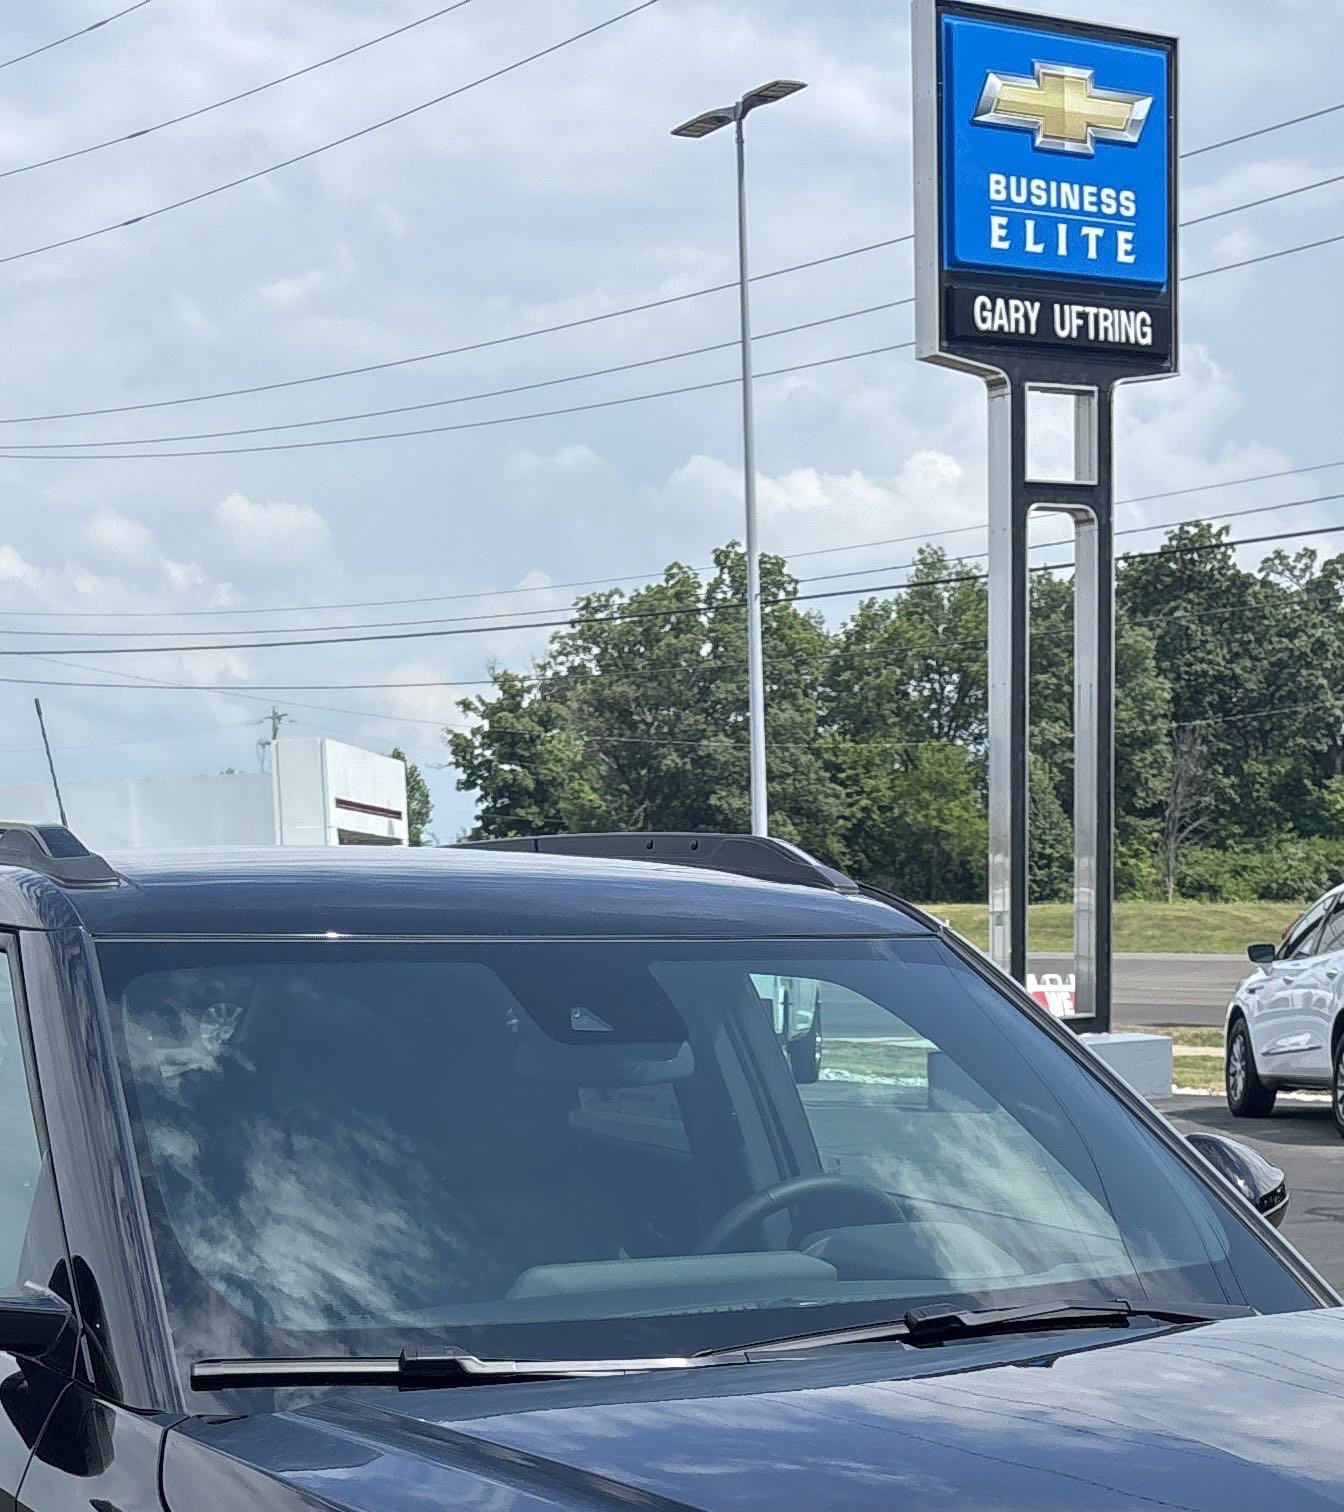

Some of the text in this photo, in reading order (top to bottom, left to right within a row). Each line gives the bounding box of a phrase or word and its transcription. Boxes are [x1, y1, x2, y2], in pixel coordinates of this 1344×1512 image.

[989, 173, 1136, 217] BUSINESS
[989, 215, 1136, 263] ELITE
[973, 295, 1153, 346] GARY UFTRING
